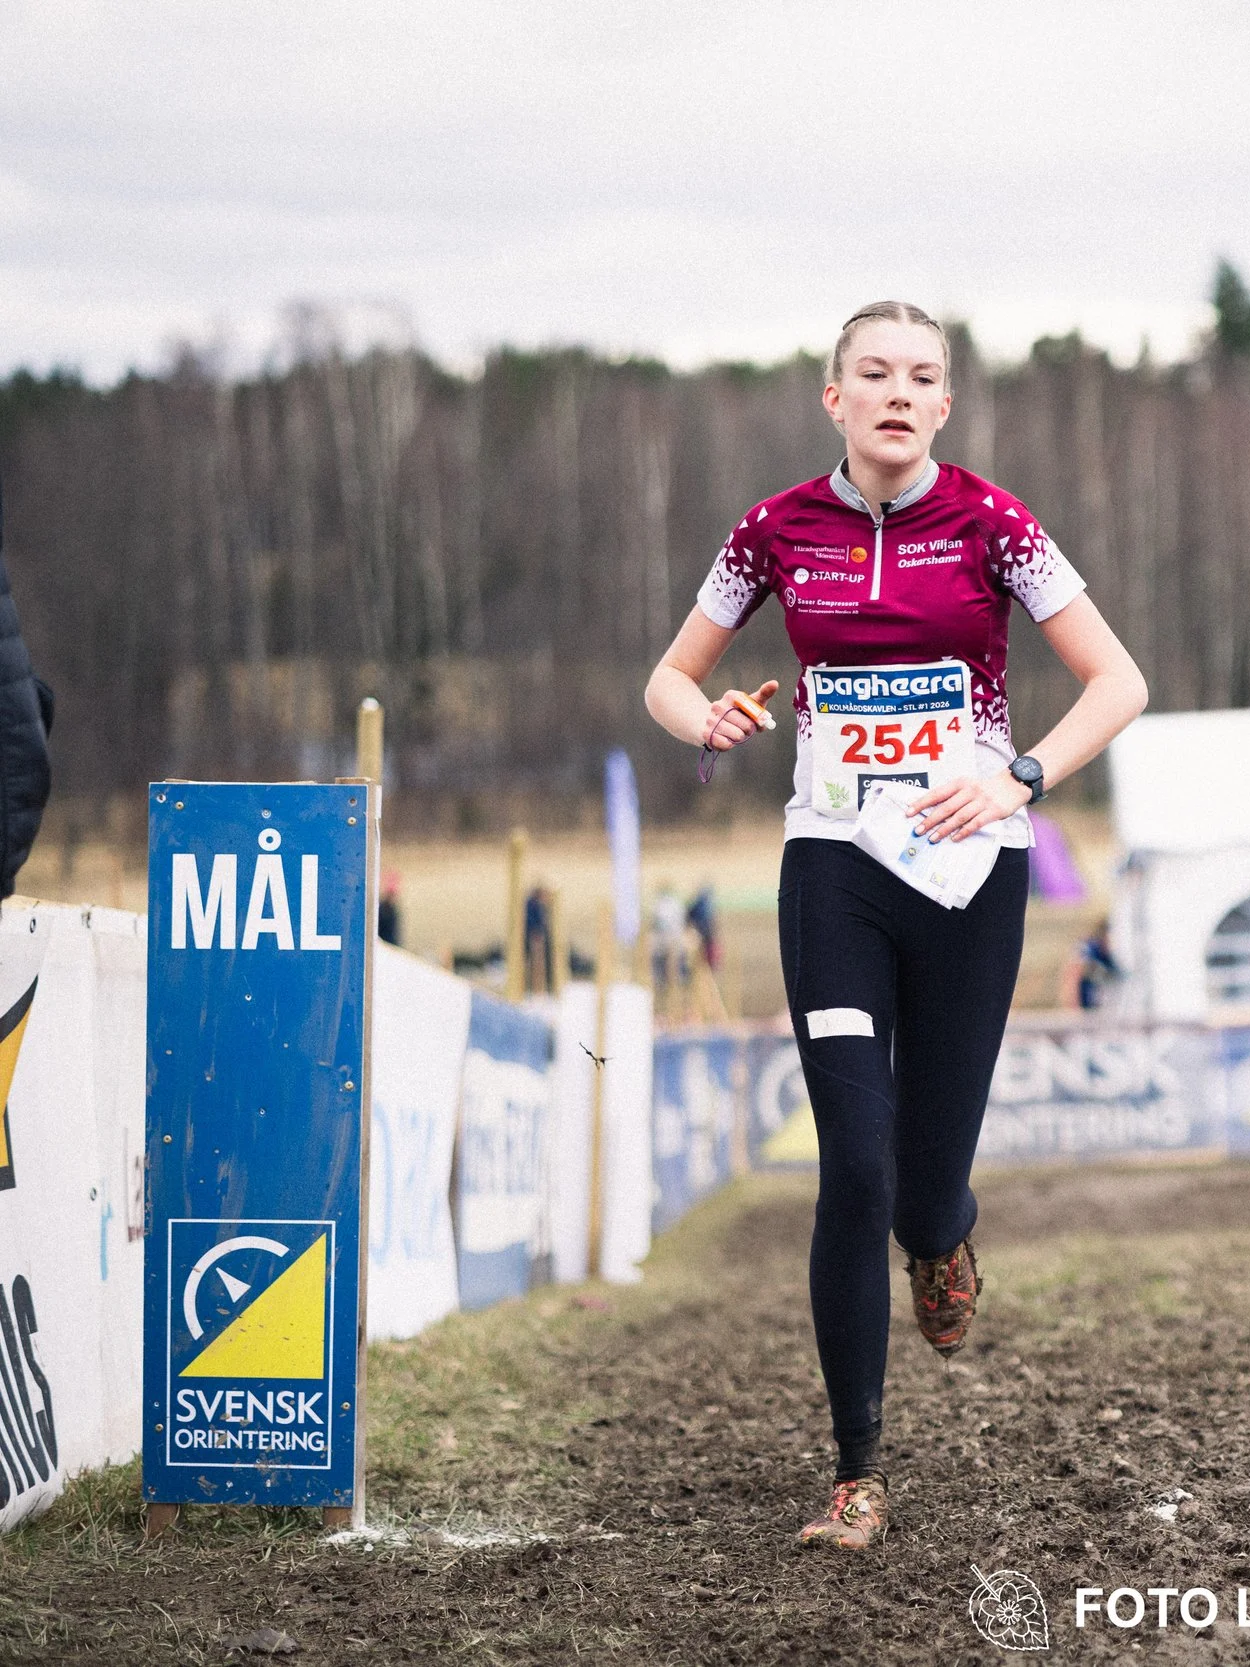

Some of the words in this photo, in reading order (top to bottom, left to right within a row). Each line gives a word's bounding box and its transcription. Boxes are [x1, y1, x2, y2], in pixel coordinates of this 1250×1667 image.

[898, 543, 926, 555] SOK
[929, 539, 963, 552] Viljan
[897, 554, 962, 568] Oskarshamn
[811, 571, 866, 583] START-UP
[813, 673, 963, 700] bagheera
[829, 702, 897, 713] KOLMÅRDSKAVLEN
[930, 701, 950, 709] 2026
[840, 719, 944, 765] 254
[946, 716, 961, 733] 4
[171, 827, 342, 950] MÅL
[175, 1389, 324, 1425] SVENSK
[174, 1428, 324, 1454] ORIENTERING
